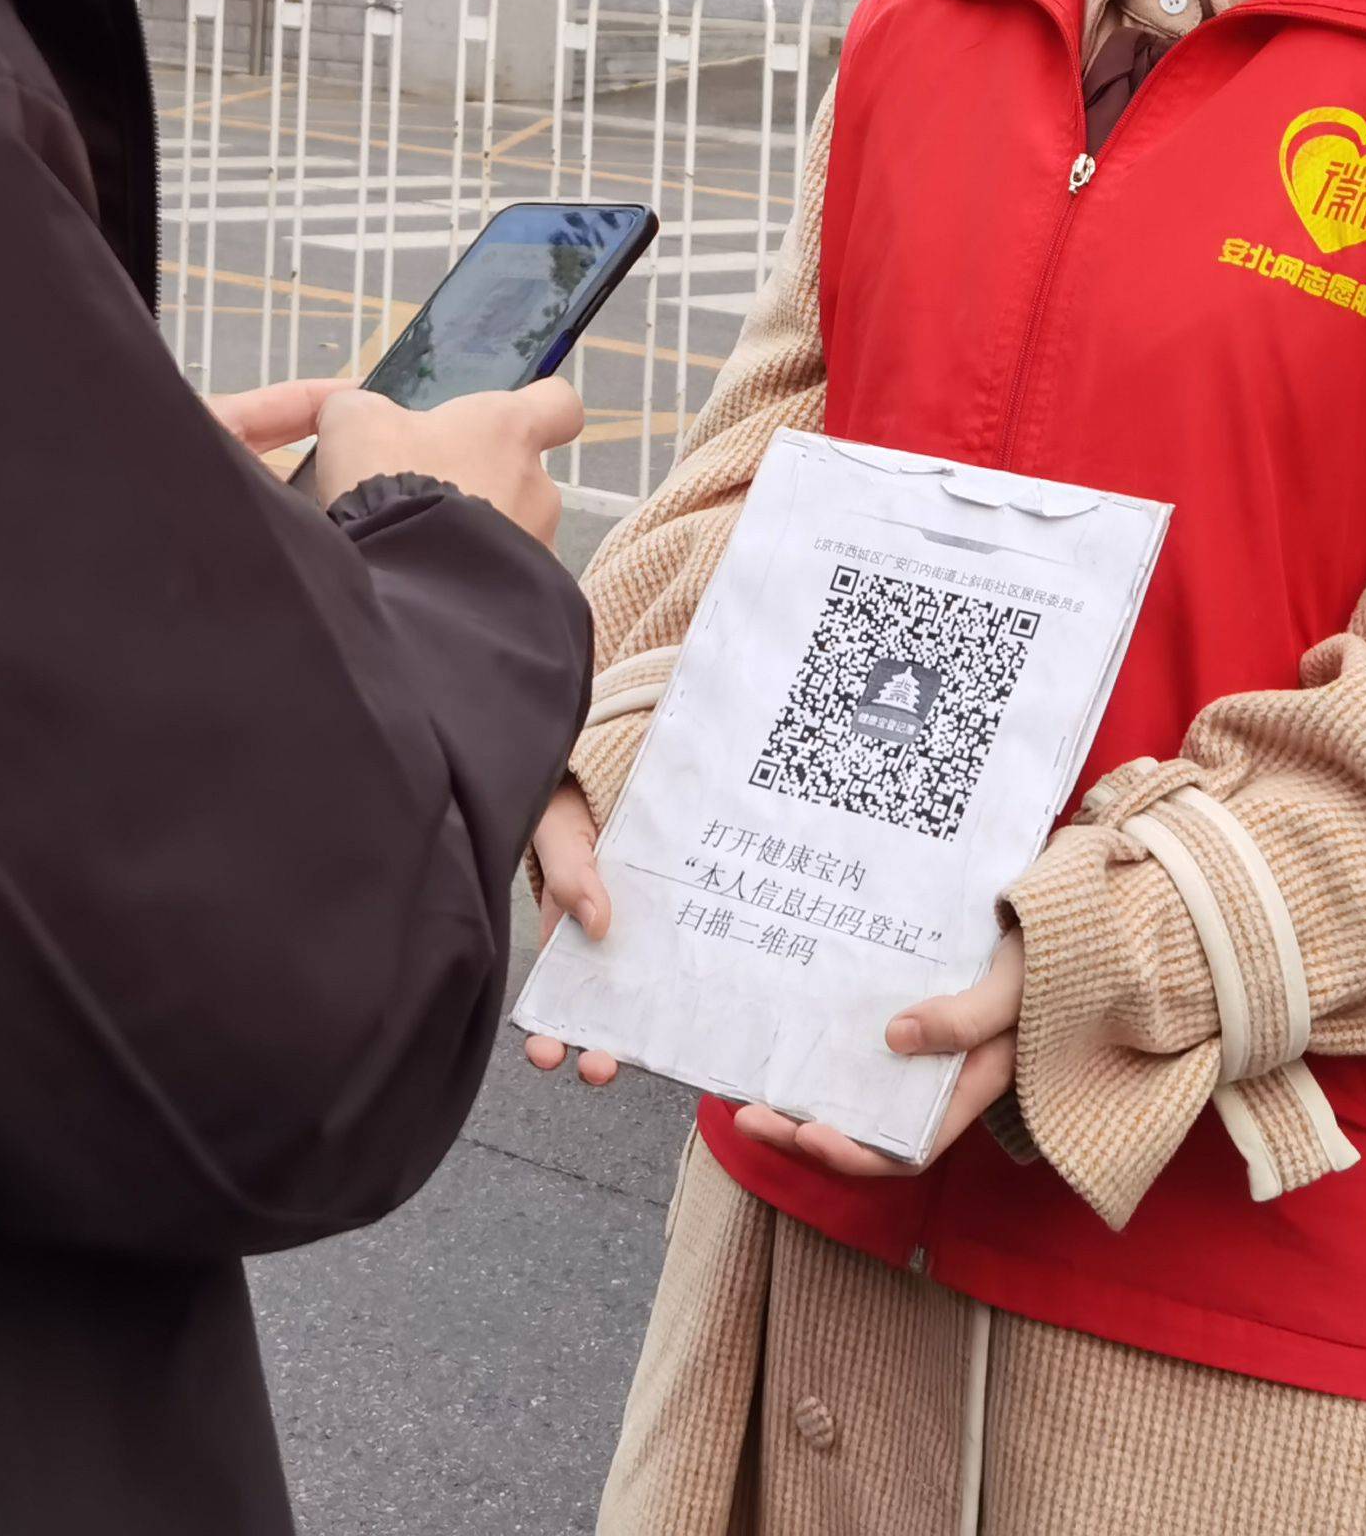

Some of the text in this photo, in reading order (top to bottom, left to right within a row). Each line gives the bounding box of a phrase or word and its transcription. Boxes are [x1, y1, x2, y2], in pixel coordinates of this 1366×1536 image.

[700, 818, 867, 892] 打开健康宝内
[676, 898, 818, 967] 扫描二维码
[685, 856, 942, 953] “本人信息扫码登记”
